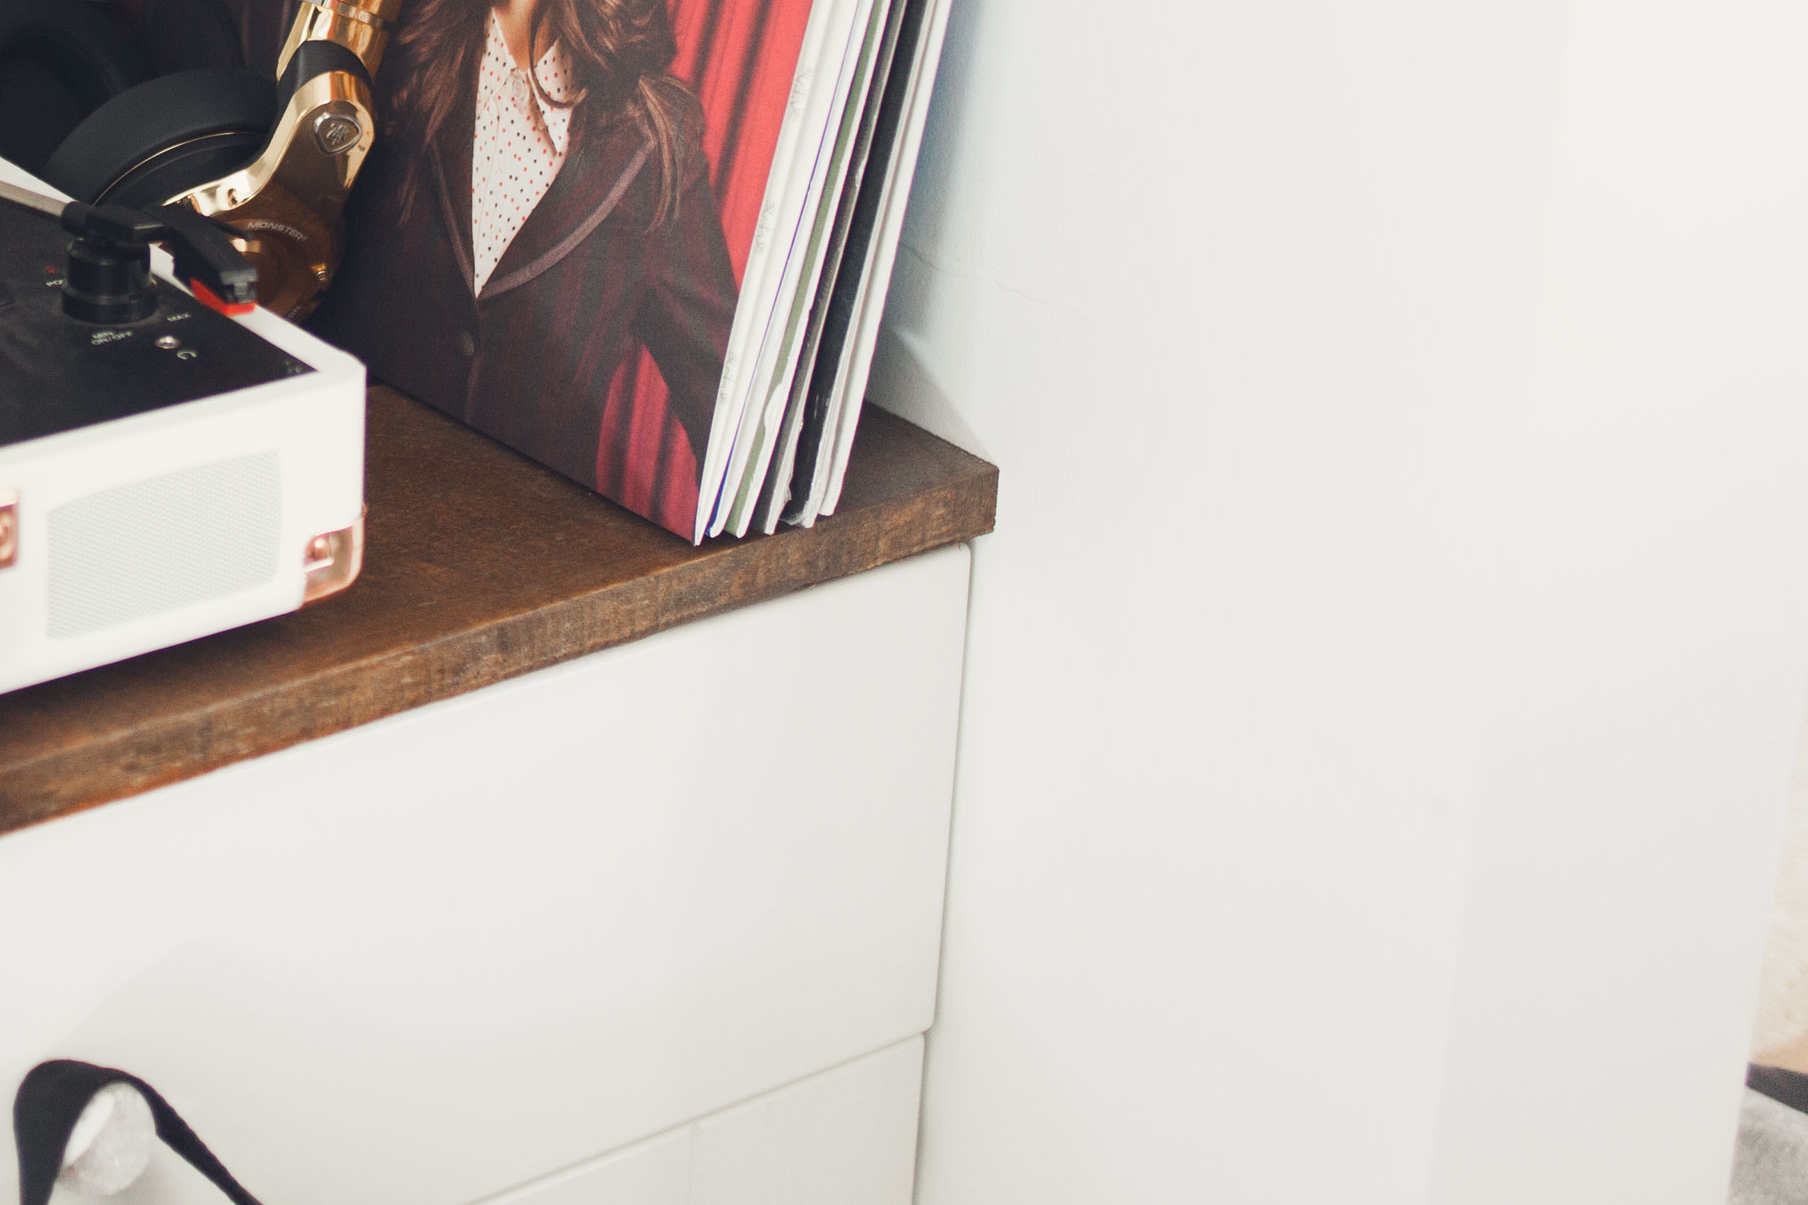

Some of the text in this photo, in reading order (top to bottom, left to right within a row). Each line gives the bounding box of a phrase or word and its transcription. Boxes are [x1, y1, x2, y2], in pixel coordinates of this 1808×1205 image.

[247, 221, 305, 242] MONSTER
[167, 313, 191, 322] MAX
[91, 331, 133, 345] ON/OFF
